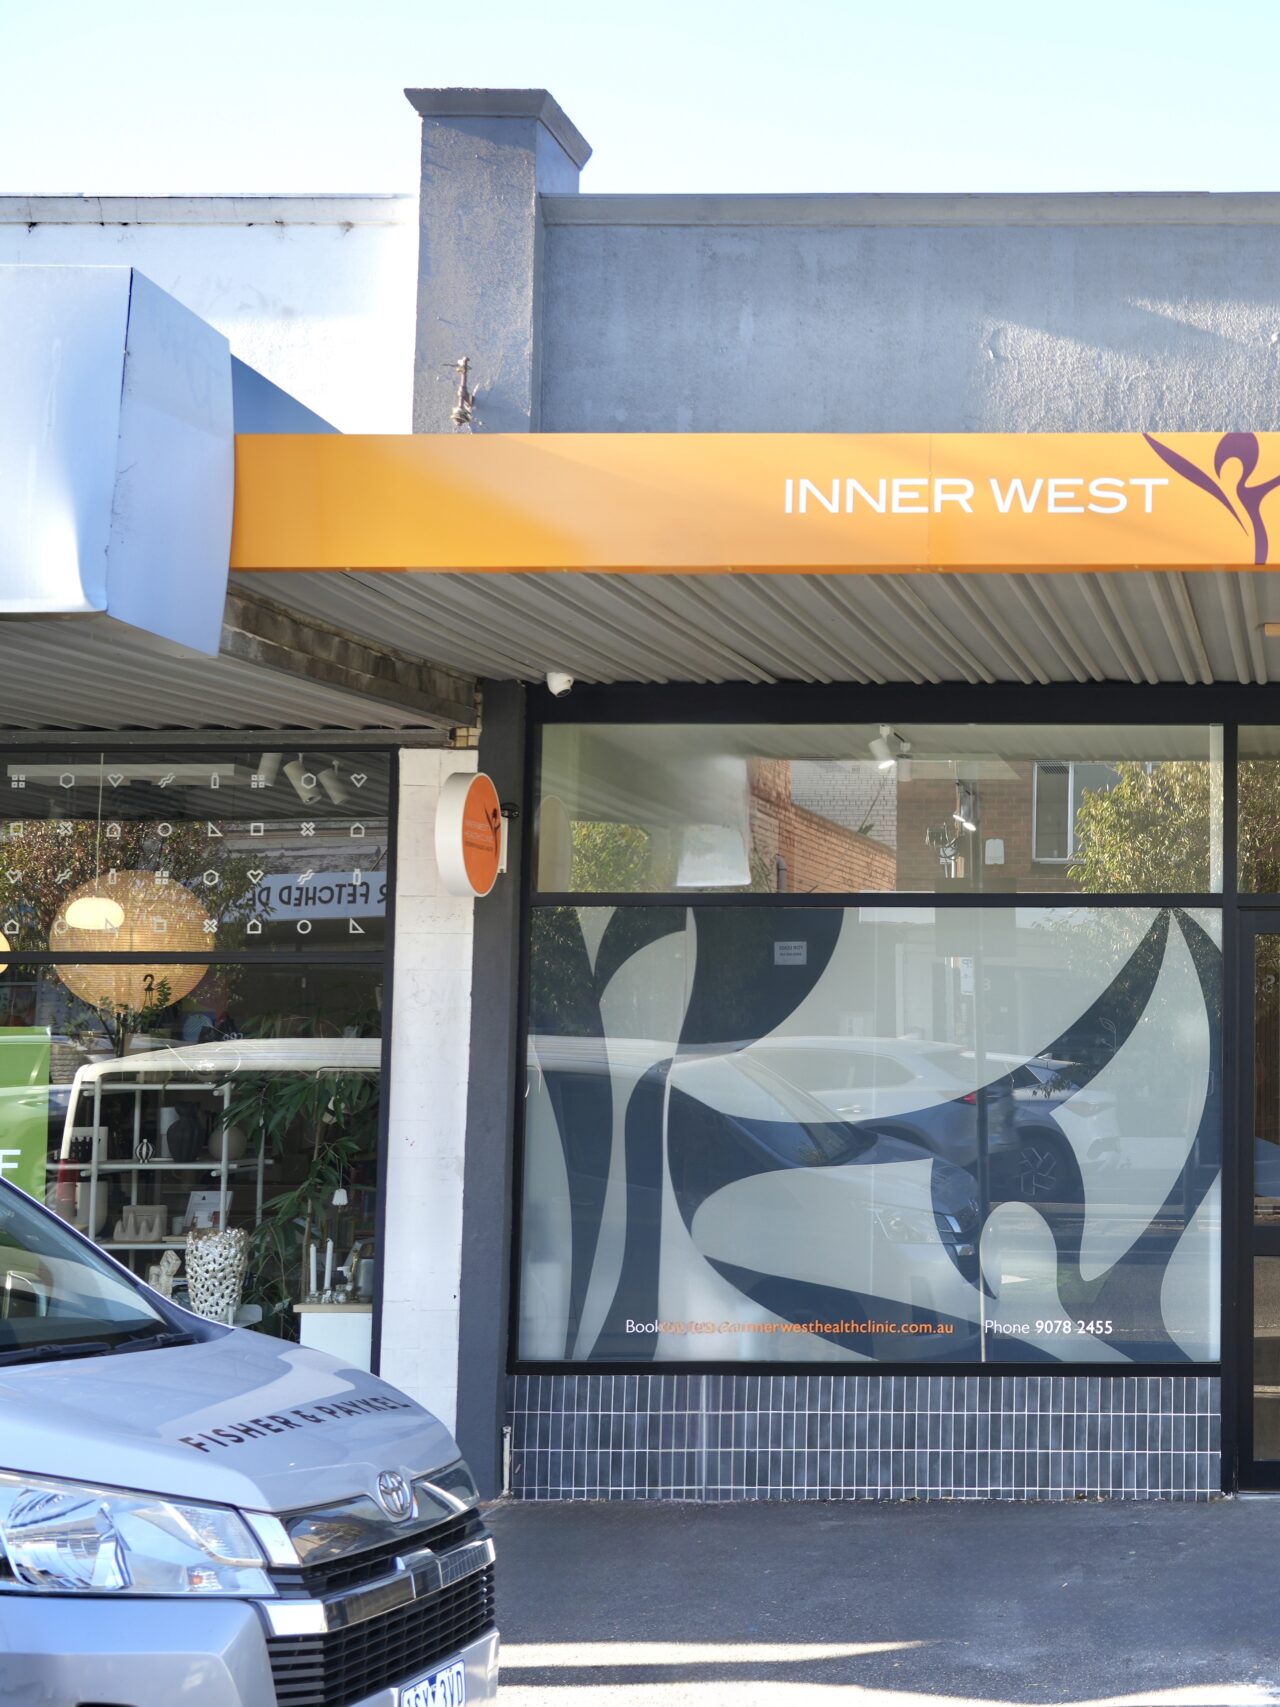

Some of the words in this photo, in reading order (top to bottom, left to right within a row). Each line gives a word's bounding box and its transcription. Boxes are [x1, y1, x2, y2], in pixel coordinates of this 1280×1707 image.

[784, 478, 975, 513] INNER
[989, 478, 1169, 514] WEST
[984, 1319, 1030, 1335] Phone
[1035, 1320, 1072, 1335] 9078
[1077, 1320, 1113, 1335] 2455
[178, 1415, 303, 1453] FISHER
[314, 1396, 412, 1419] PAYKEL
